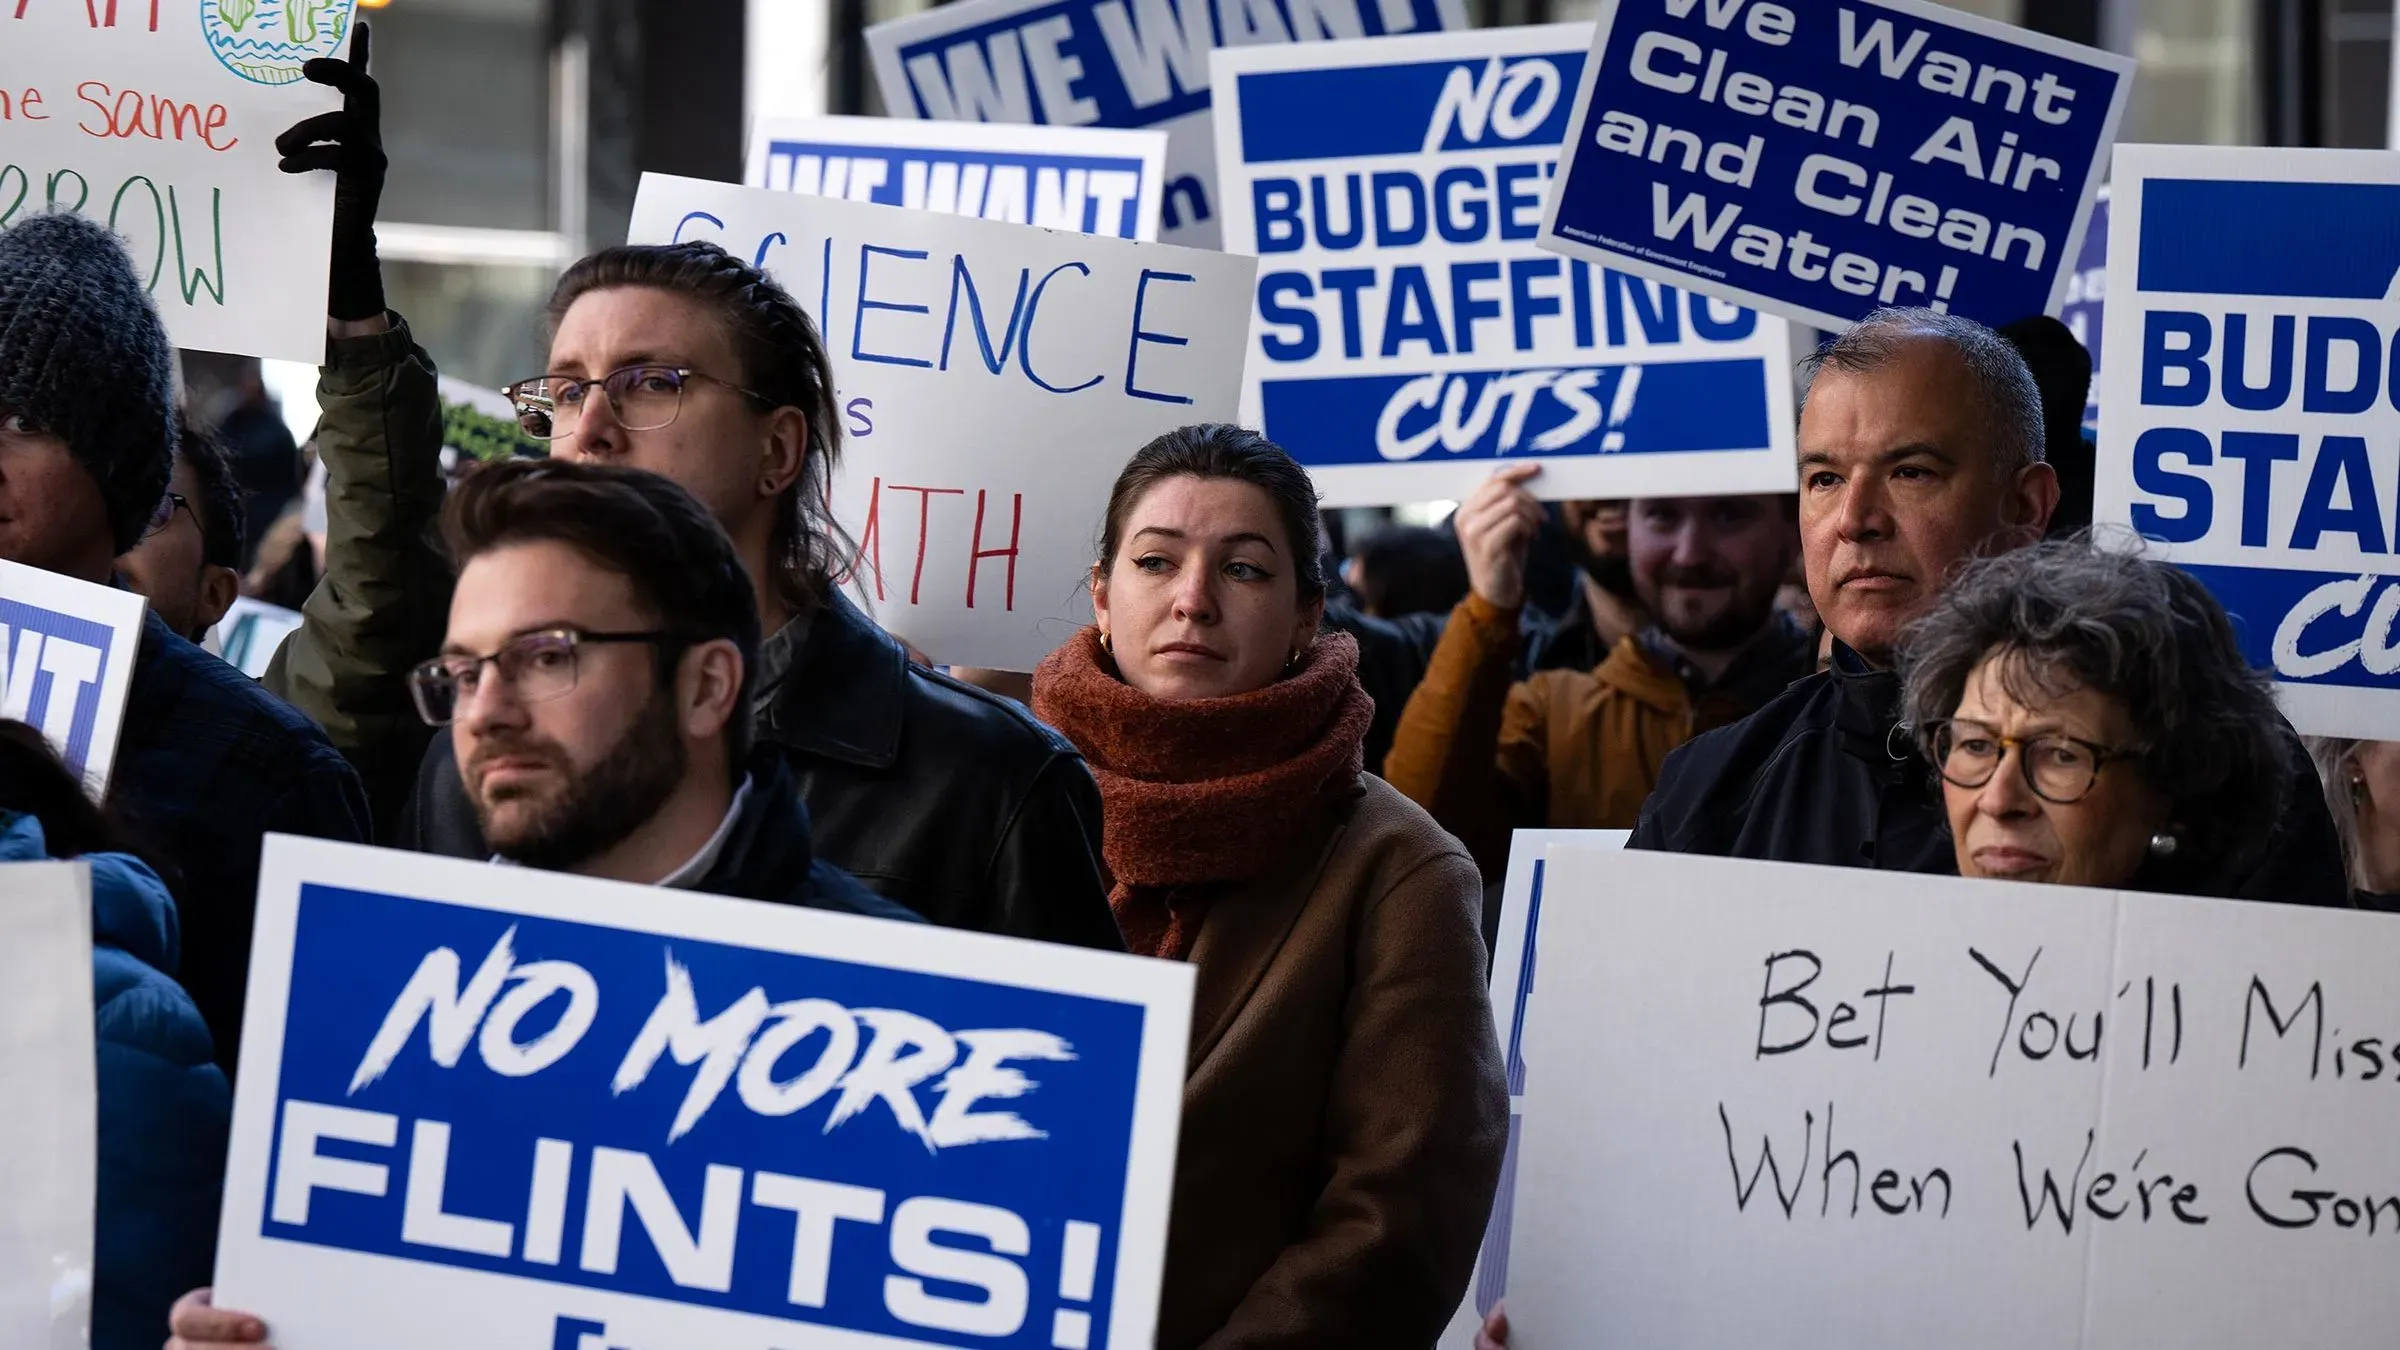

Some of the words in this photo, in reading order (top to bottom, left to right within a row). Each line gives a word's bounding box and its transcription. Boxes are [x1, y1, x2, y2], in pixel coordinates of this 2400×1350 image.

[76, 81, 239, 151] same
[905, 13, 1101, 126] WE
[1422, 55, 1562, 153] NO
[1628, 30, 1881, 148] Clean
[1910, 116, 2062, 192] Air
[1837, 8, 2076, 125] Want
[900, 160, 1140, 239] WANT
[1252, 159, 1560, 254] BUDGE
[1562, 224, 1598, 241] American
[1598, 233, 1636, 253] Federation
[1645, 247, 1689, 267] Government
[1688, 260, 1727, 279] Employees
[1595, 110, 1766, 189] and
[1794, 153, 2047, 271] Clean
[1650, 181, 1960, 314] Water!
[672, 211, 1194, 405] IENCE
[2140, 309, 2400, 414] BUD
[836, 390, 873, 437] s
[1376, 363, 1643, 460] CUTS!
[825, 476, 1022, 611] UTH
[2130, 426, 2400, 554] STA
[347, 923, 598, 1097] NO
[610, 946, 1078, 1156] MORE
[1756, 950, 1915, 1062] Bet
[1968, 946, 2183, 1079] You'll
[2238, 973, 2400, 1083] Mis
[269, 1098, 1101, 1350] FLINTS!
[1718, 1101, 1952, 1220] When
[2013, 1130, 2209, 1236] We're
